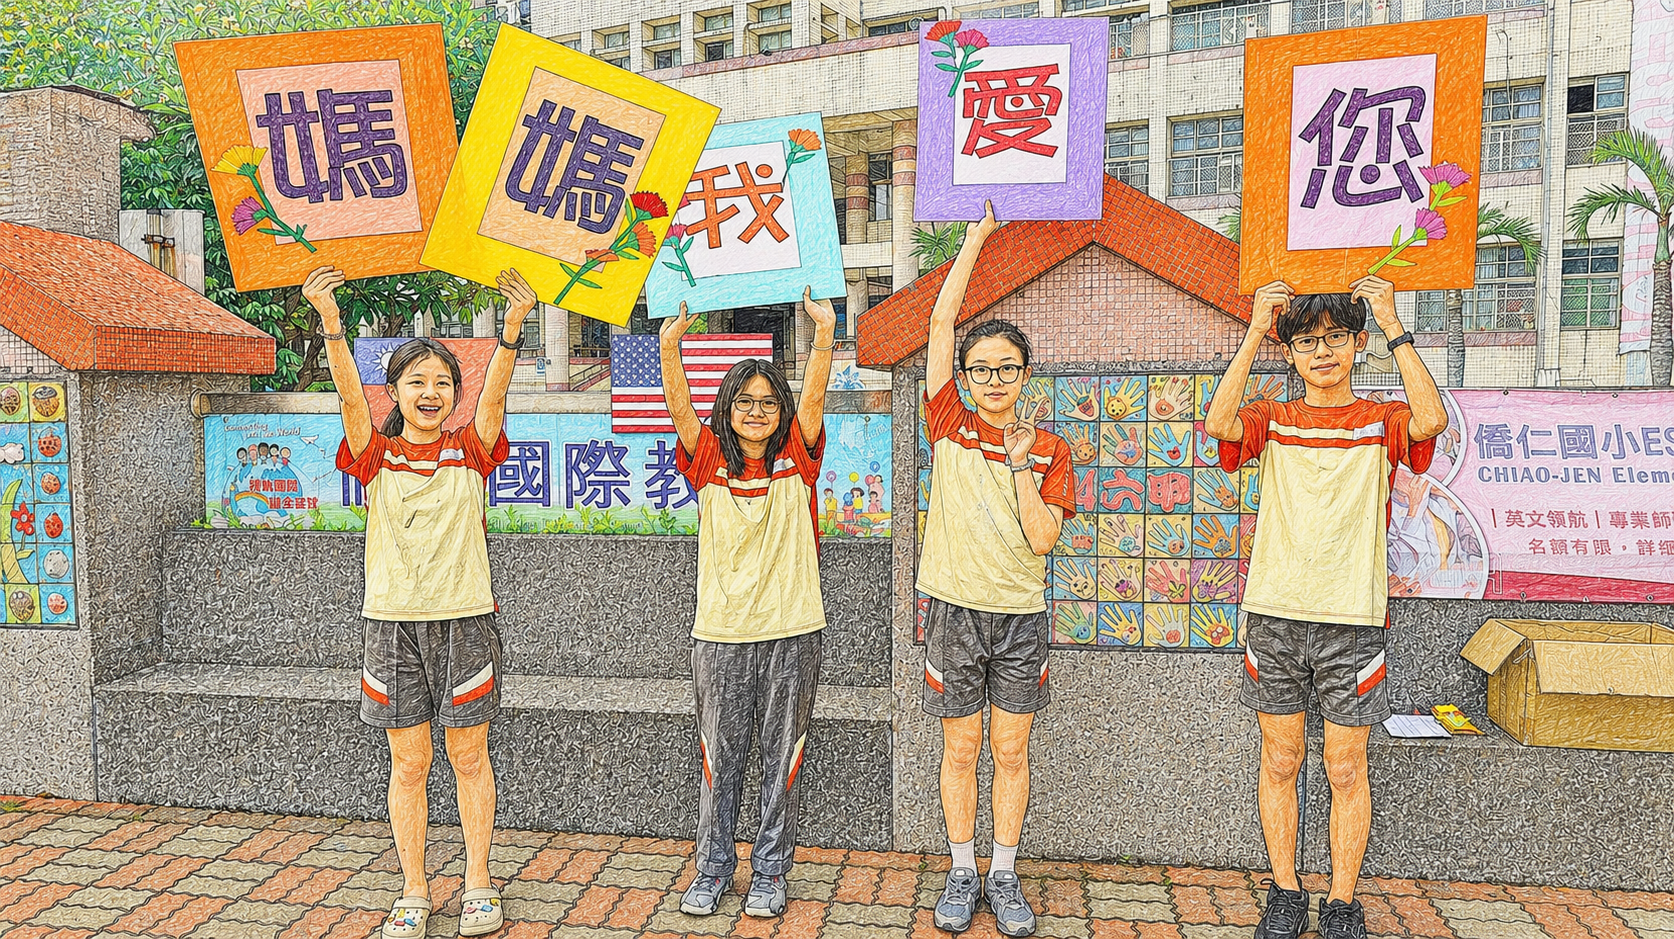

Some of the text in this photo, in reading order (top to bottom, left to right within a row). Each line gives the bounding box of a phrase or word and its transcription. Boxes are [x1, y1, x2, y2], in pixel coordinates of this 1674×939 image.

[256, 88, 407, 204] 媽
[961, 63, 1060, 159] 愛
[1299, 86, 1426, 208] 您
[505, 99, 644, 234] 媽
[685, 161, 790, 249] 我
[1478, 466, 1602, 484] CHIAO-JEN
